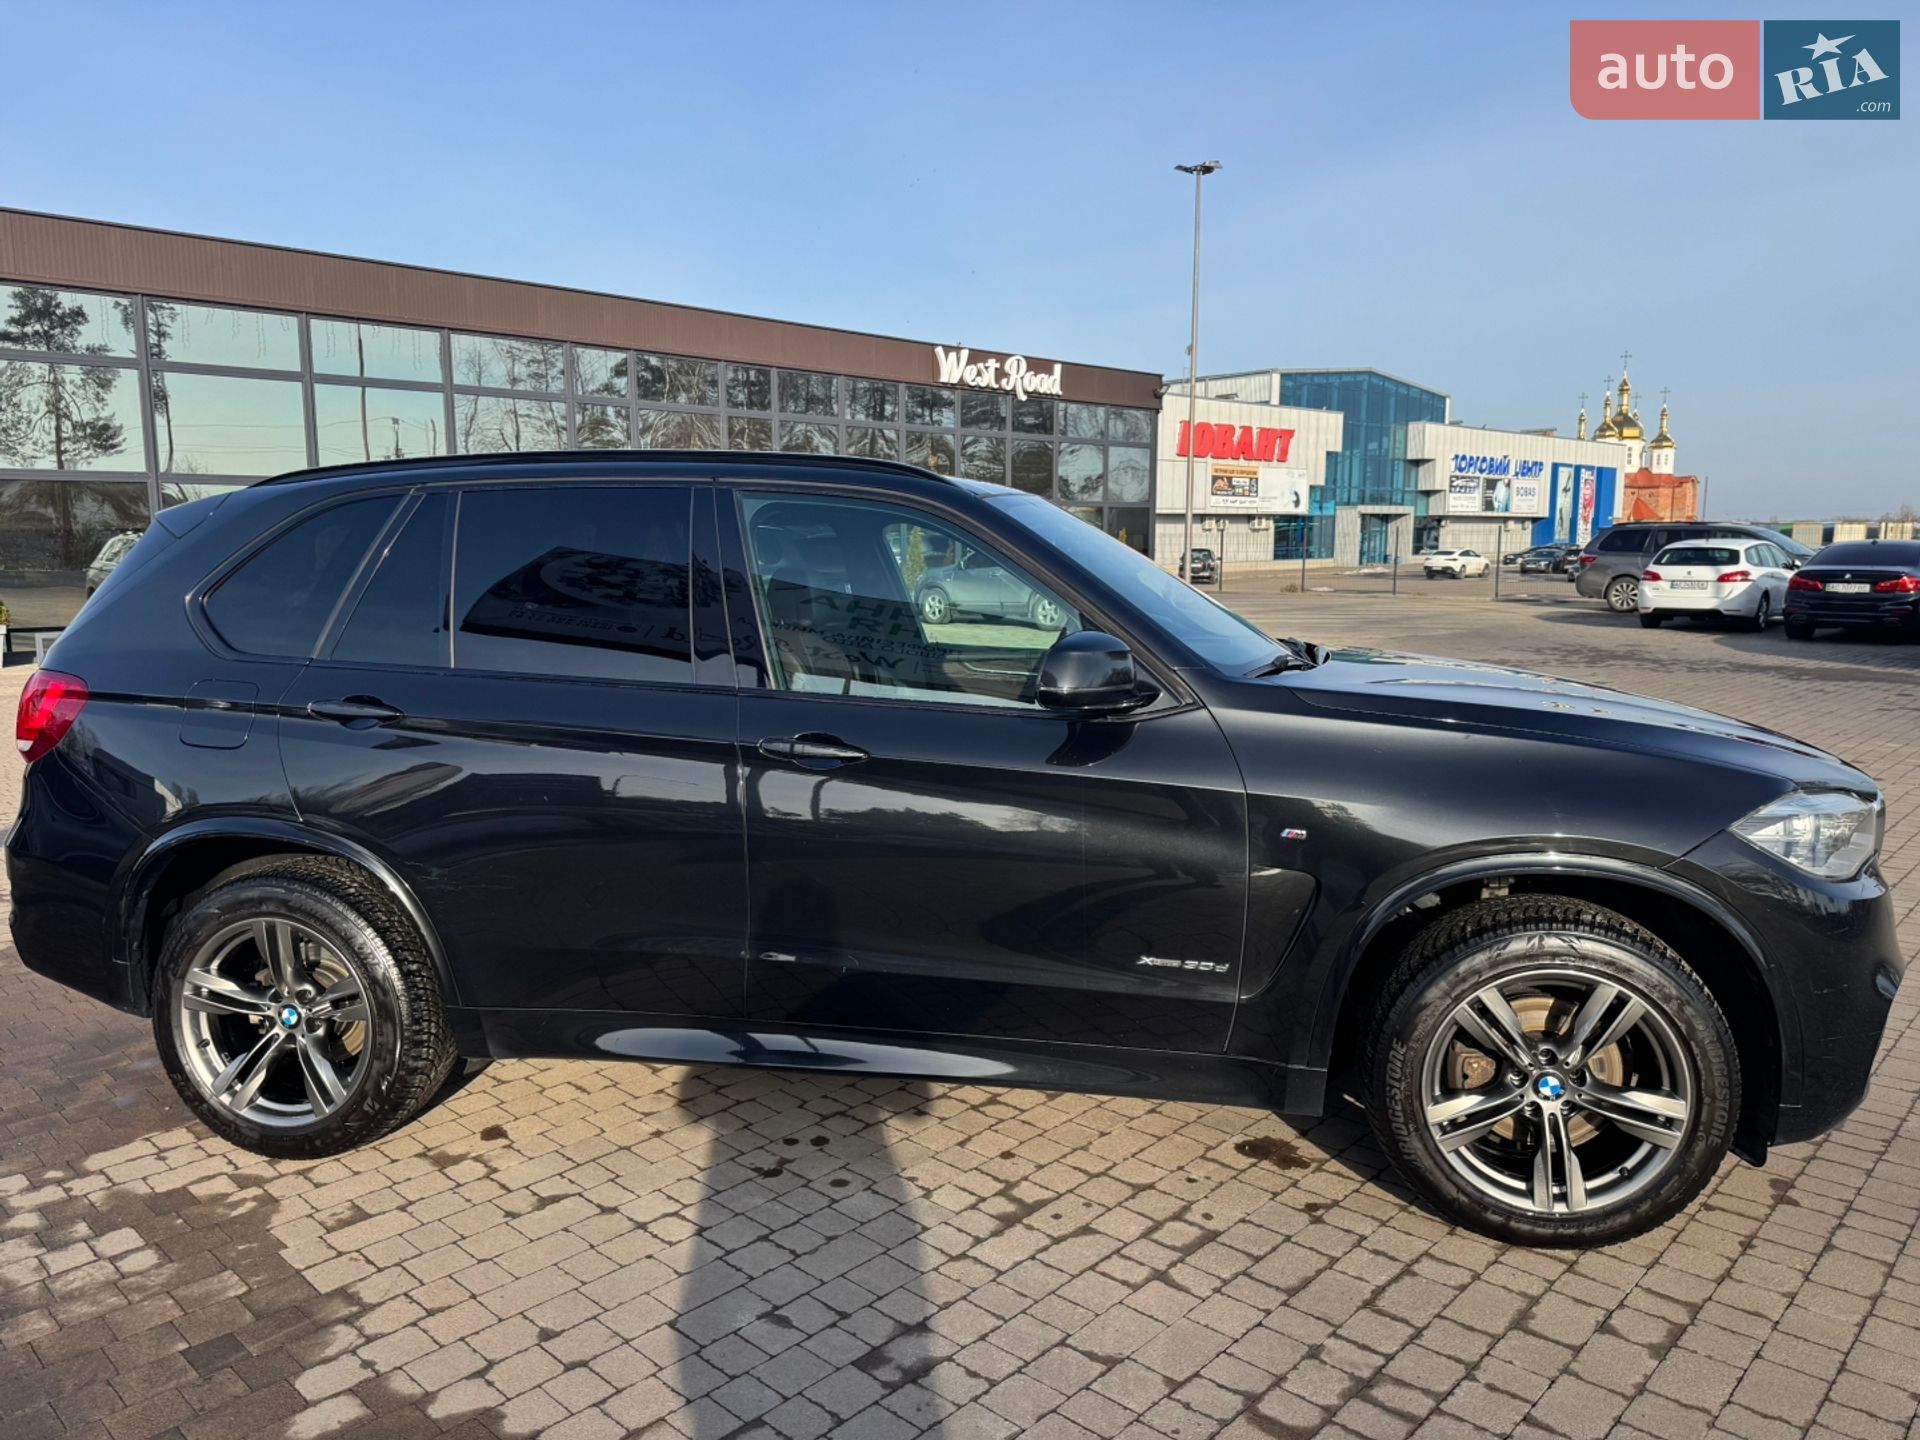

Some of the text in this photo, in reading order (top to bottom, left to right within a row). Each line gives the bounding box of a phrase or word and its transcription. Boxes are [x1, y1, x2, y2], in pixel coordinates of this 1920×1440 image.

[934, 345, 1063, 402] West Road
[1452, 453, 1545, 480] ТОРГОВИЙ ЦЕНТР
[1386, 1037, 1423, 1168] BRIDGESTONE
